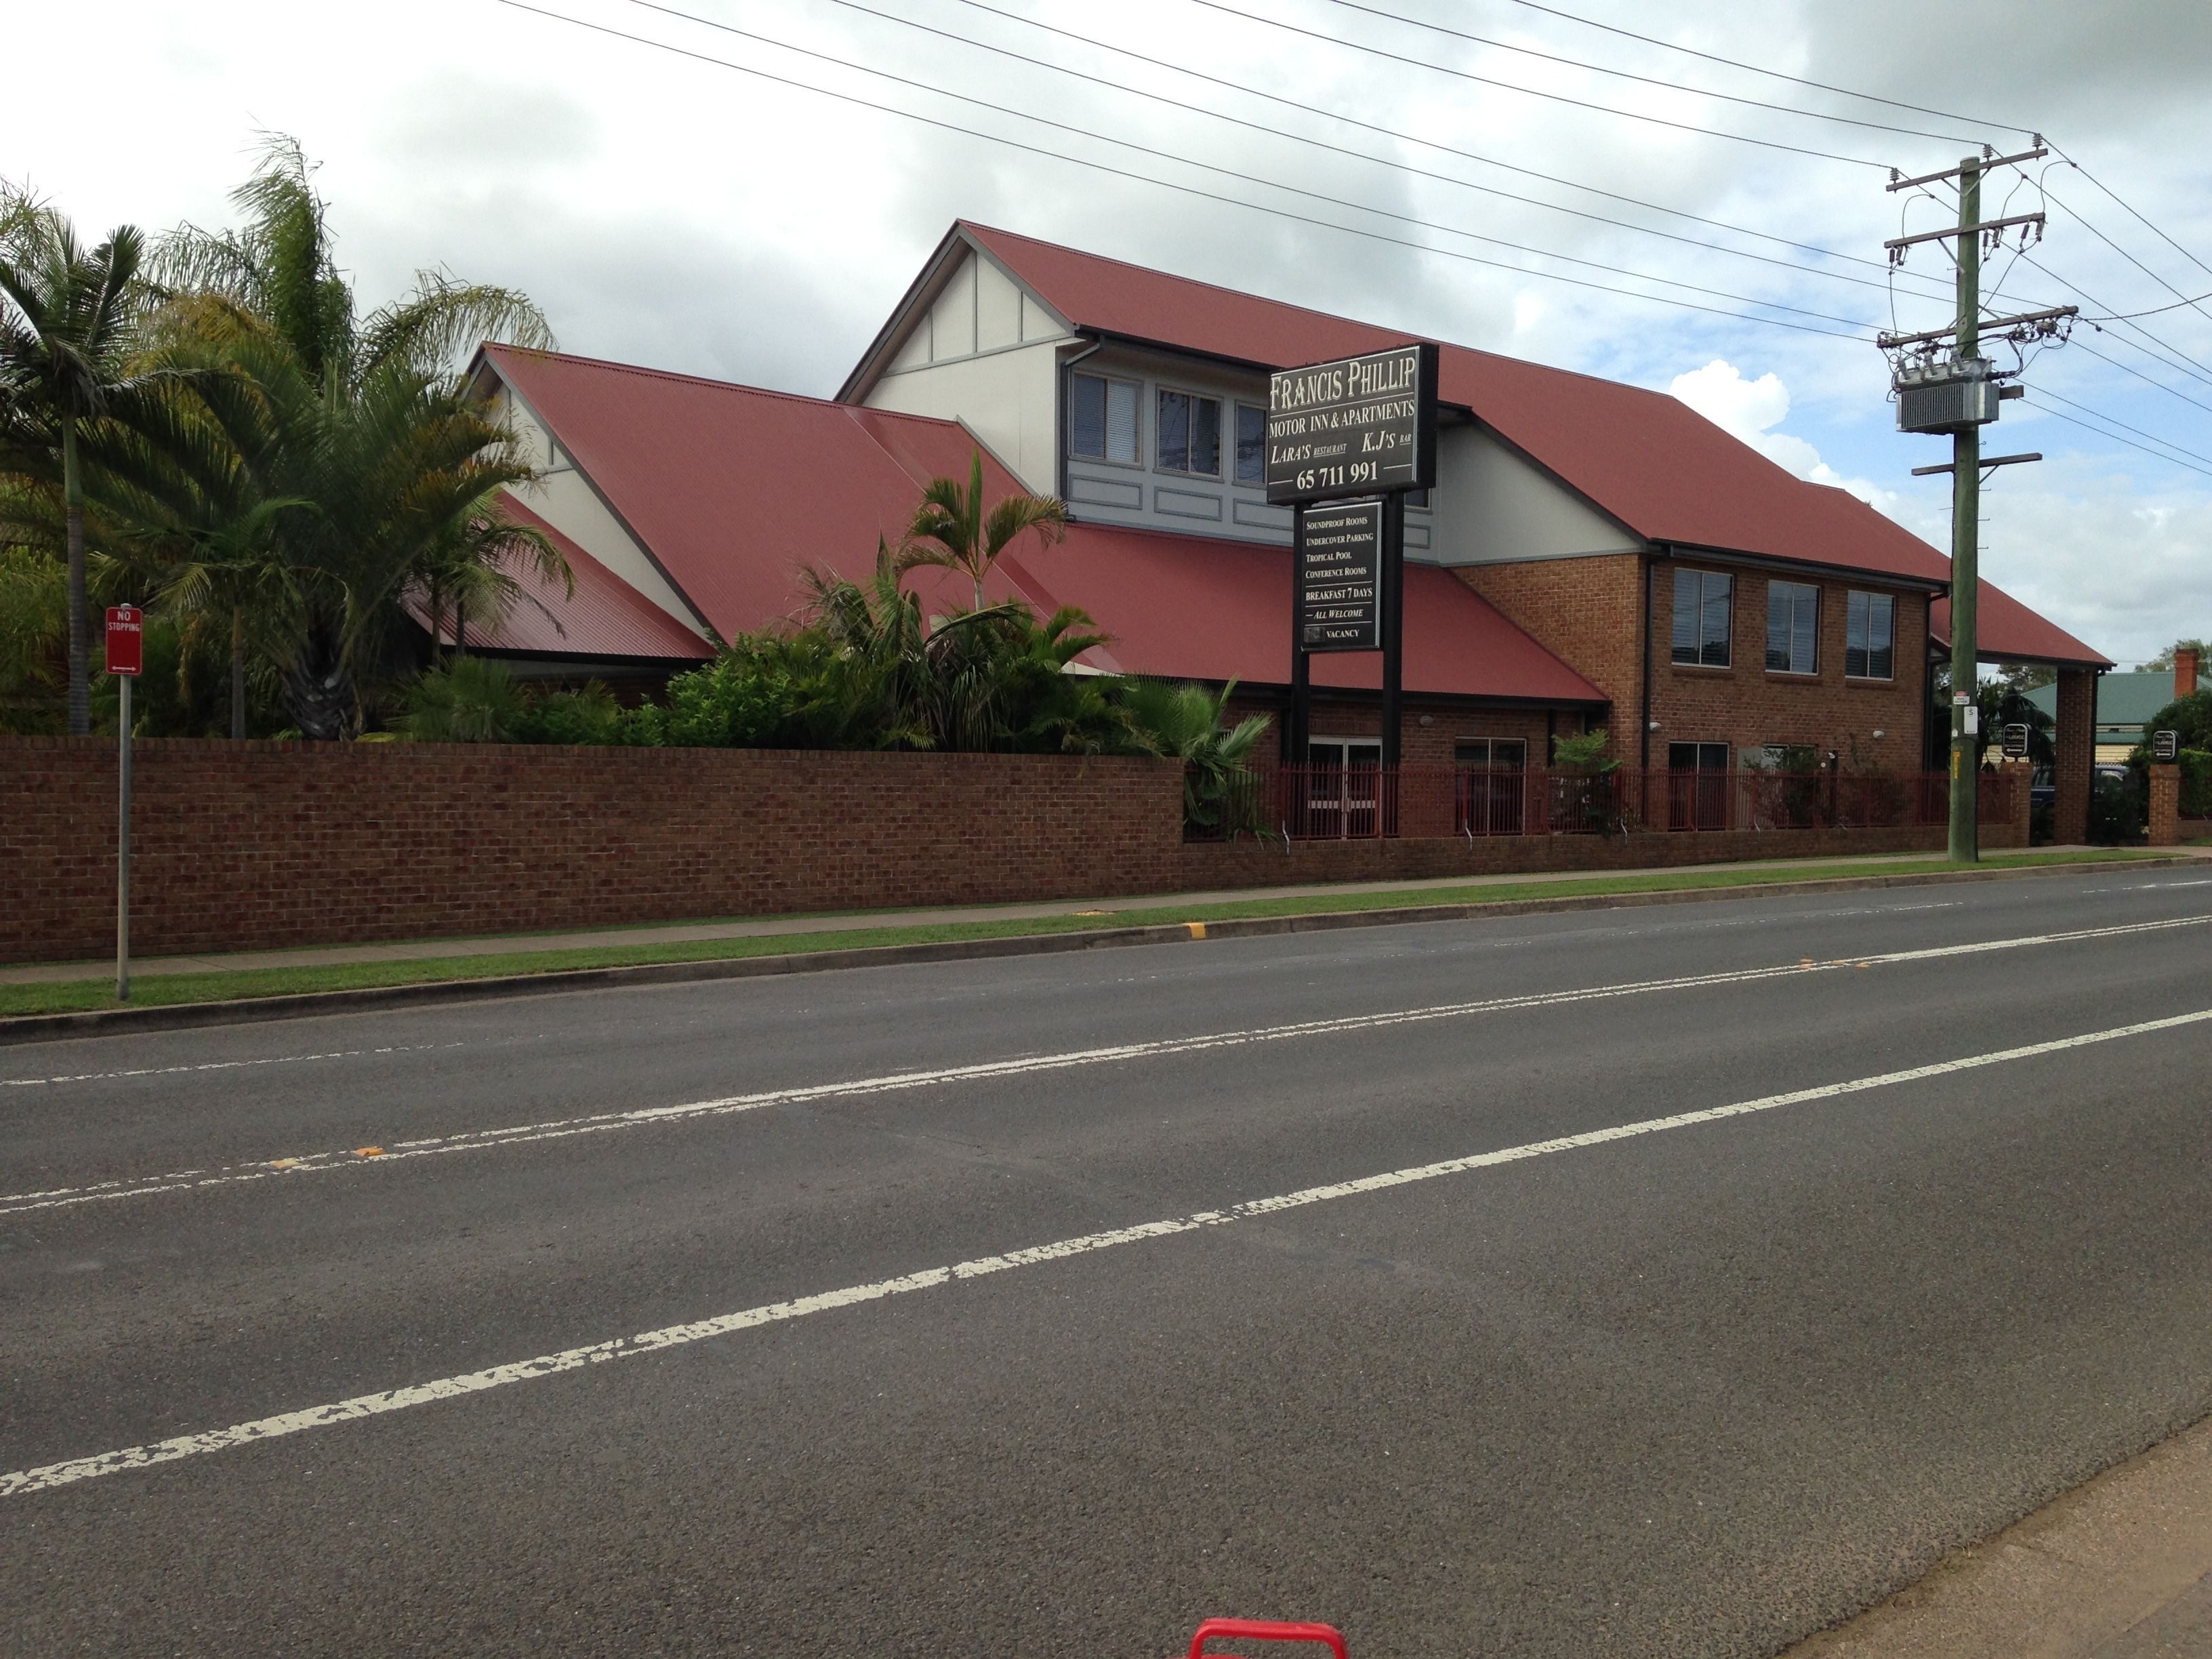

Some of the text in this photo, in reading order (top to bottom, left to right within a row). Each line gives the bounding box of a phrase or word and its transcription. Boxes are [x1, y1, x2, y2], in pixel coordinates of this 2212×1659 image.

[1270, 357, 1416, 411] FRANCIS PHILLIP
[1269, 399, 1415, 439] MOTOR INN & APARTMENTS
[1271, 443, 1311, 464] LARA'S
[1313, 443, 1347, 456] RESTAURANT
[1399, 434, 1412, 443] BAR
[1296, 461, 1378, 490] 65 711 991
[1306, 516, 1368, 530] SOUNDPROOF ROOMS
[1306, 533, 1374, 546] UNDERCOVER PARKING
[1306, 551, 1352, 562] TROPICAL POOL
[1305, 567, 1367, 579] CONFERENCE ROOMS
[1305, 588, 1372, 601] BREAKFAST 7 DAYS
[117, 611, 131, 621] NO
[1313, 609, 1364, 619] ALL WELCOME
[108, 622, 140, 632] STOPPING
[1326, 630, 1359, 638] VACANCY
